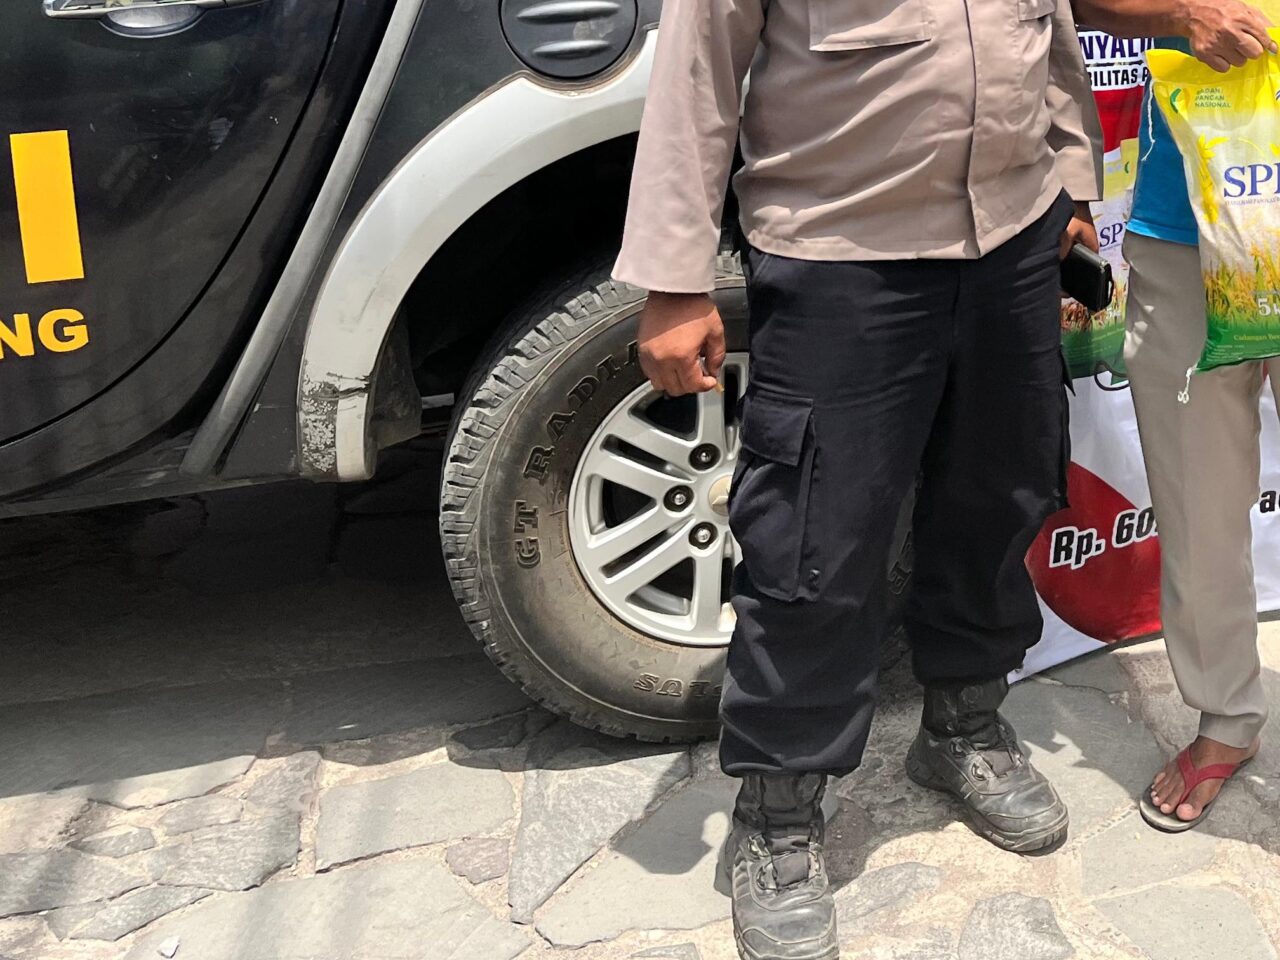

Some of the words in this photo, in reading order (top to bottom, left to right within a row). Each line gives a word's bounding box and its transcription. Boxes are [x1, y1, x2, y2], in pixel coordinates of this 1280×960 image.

[1099, 222, 1128, 247] SP
[1258, 297, 1271, 317] 5
[514, 499, 541, 569] GT
[1052, 528, 1102, 567] Rp.
